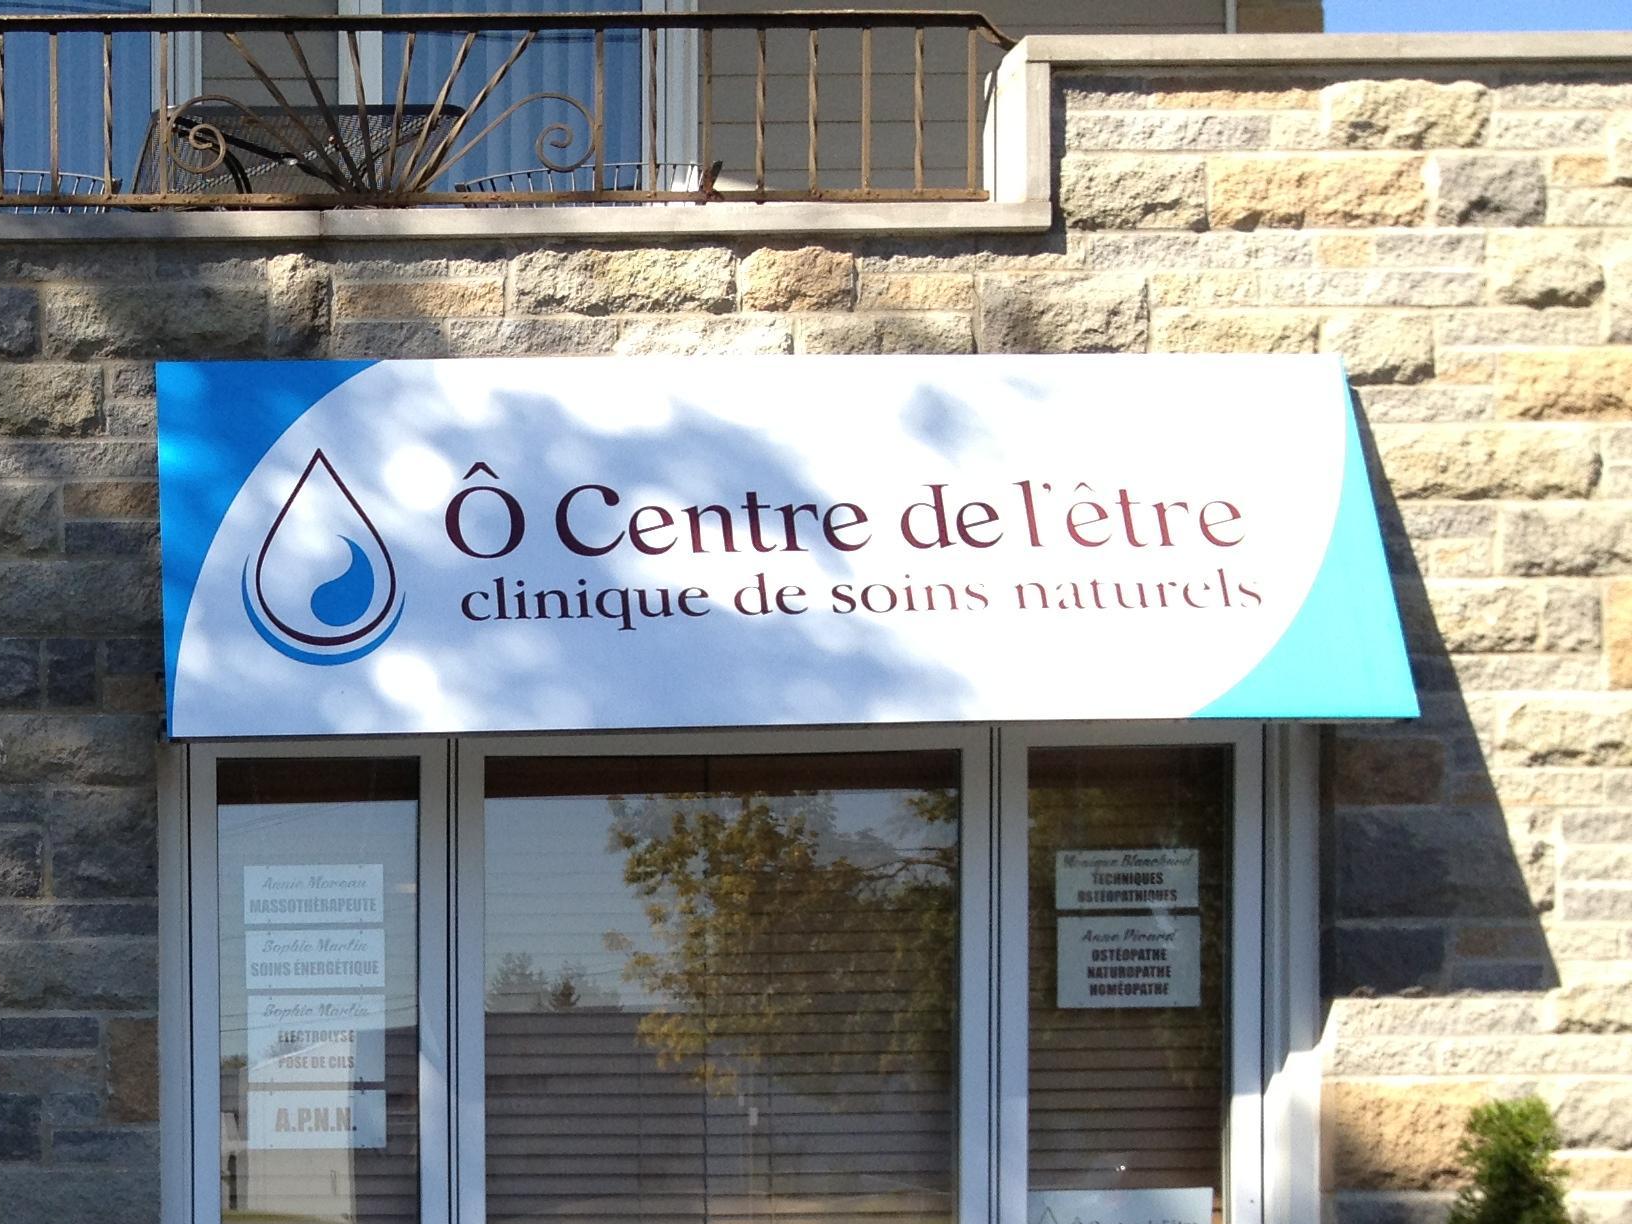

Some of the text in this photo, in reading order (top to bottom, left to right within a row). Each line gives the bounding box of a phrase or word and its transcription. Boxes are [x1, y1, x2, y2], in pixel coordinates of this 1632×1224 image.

[445, 462, 1246, 559] Ô Centre de l'être
[461, 568, 1263, 632] clinique de soins naturels
[1091, 872, 1164, 886] TECHNIQUES
[250, 897, 377, 913] MASSOTHÉRAPEUTE
[262, 938, 369, 956] Sophie Martin
[250, 958, 379, 977] SOINS ÉNERGÉTIQUE
[1087, 965, 1172, 979] NATUROPATHE
[1089, 981, 1170, 997] HOMÉOPATHE
[263, 1003, 369, 1022] Sophie Martin
[278, 1055, 355, 1069] POSE DE CILS
[275, 1107, 357, 1132] A.P.N.N.
